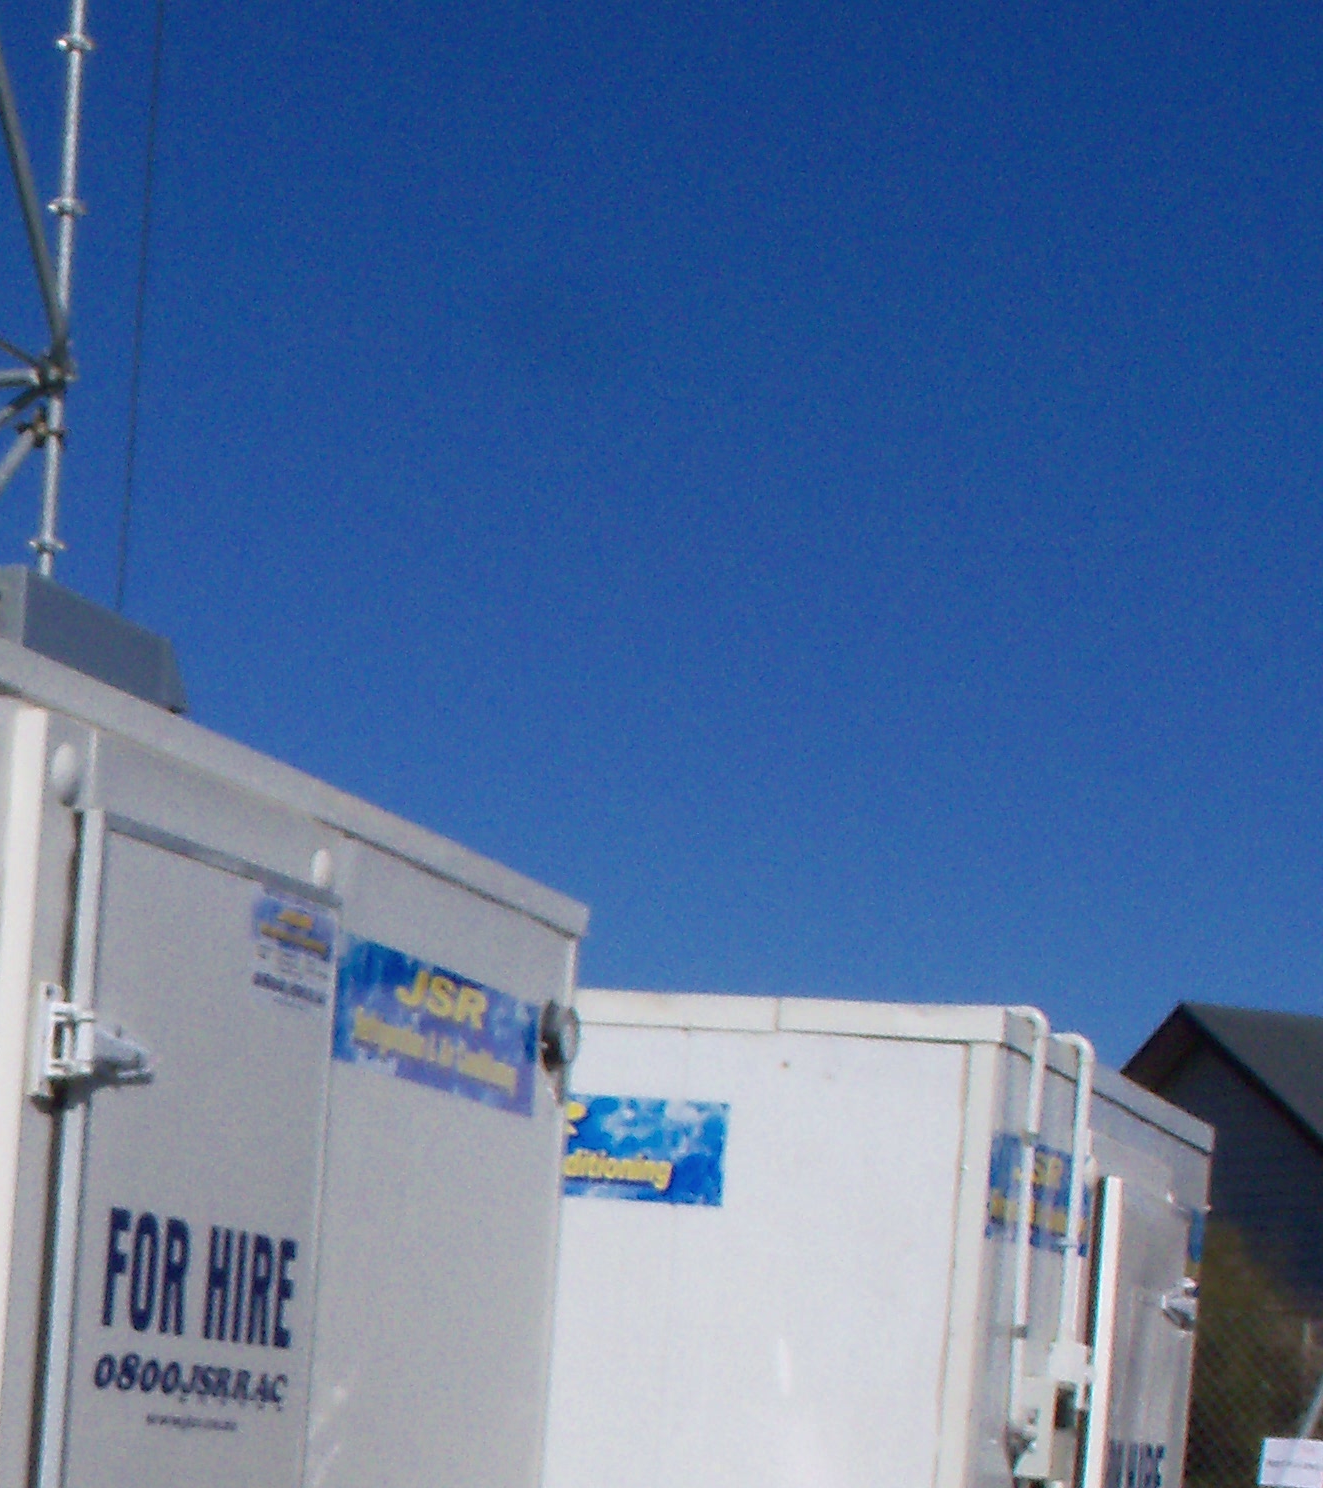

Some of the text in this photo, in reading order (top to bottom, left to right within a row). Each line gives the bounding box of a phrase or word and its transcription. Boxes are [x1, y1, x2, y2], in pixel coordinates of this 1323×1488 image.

[395, 970, 489, 1031] JSR
[101, 1206, 299, 1349] FOR HIRE
[93, 1352, 289, 1404] 0800JSRRAC
